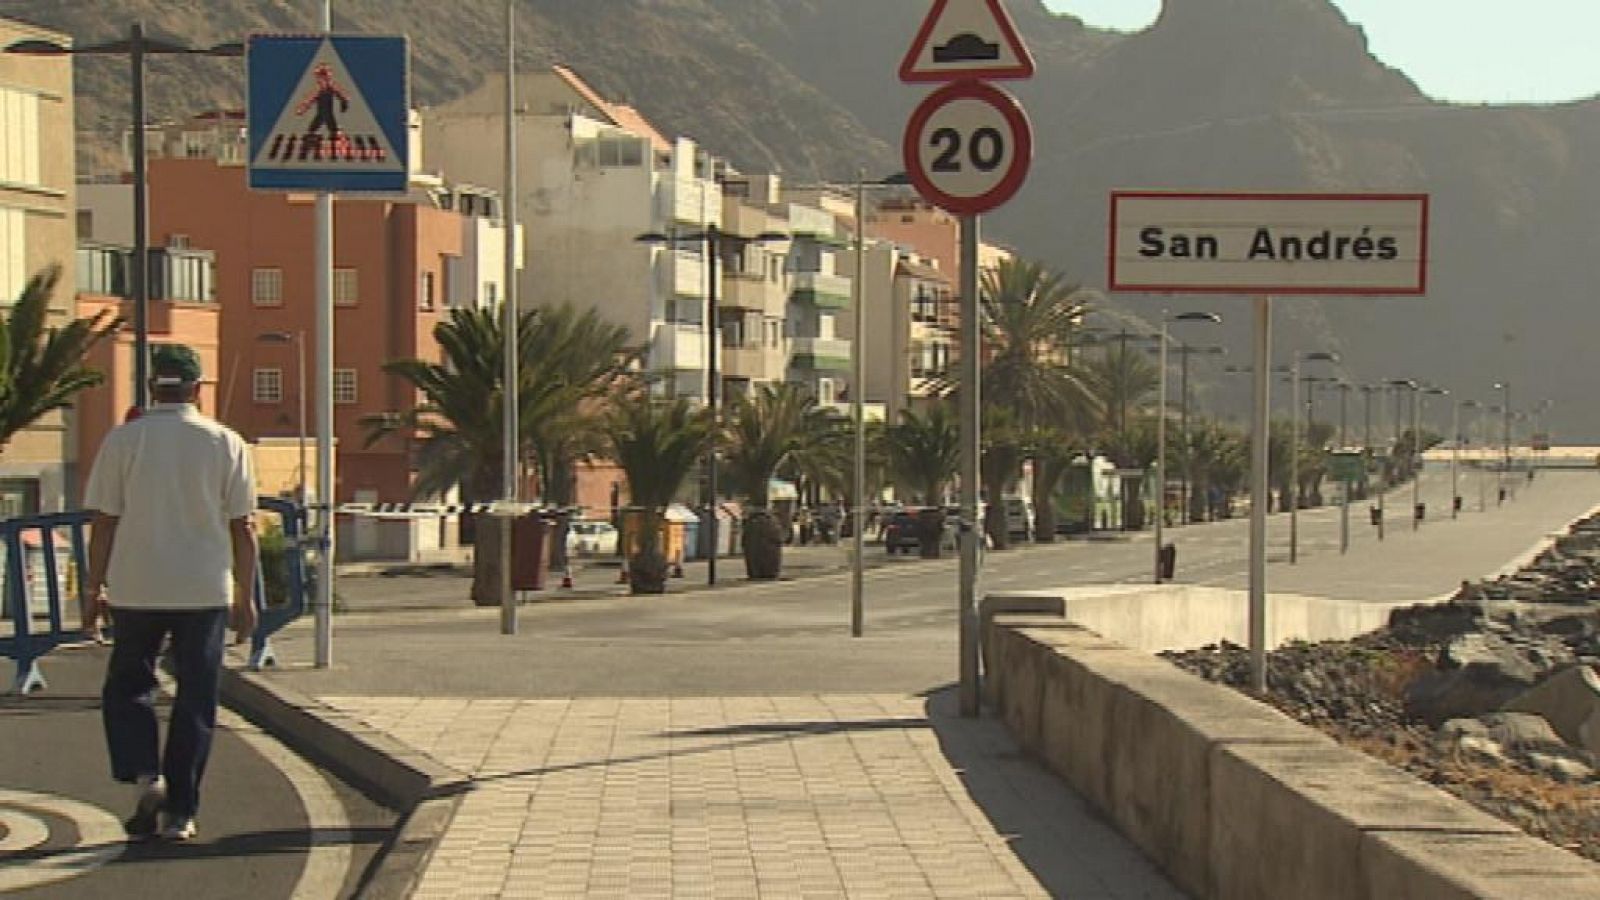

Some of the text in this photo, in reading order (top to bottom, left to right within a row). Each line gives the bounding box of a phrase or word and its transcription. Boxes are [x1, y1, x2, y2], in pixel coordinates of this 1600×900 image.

[930, 127, 1005, 172] 20
[1138, 226, 1399, 261] San Andrés
